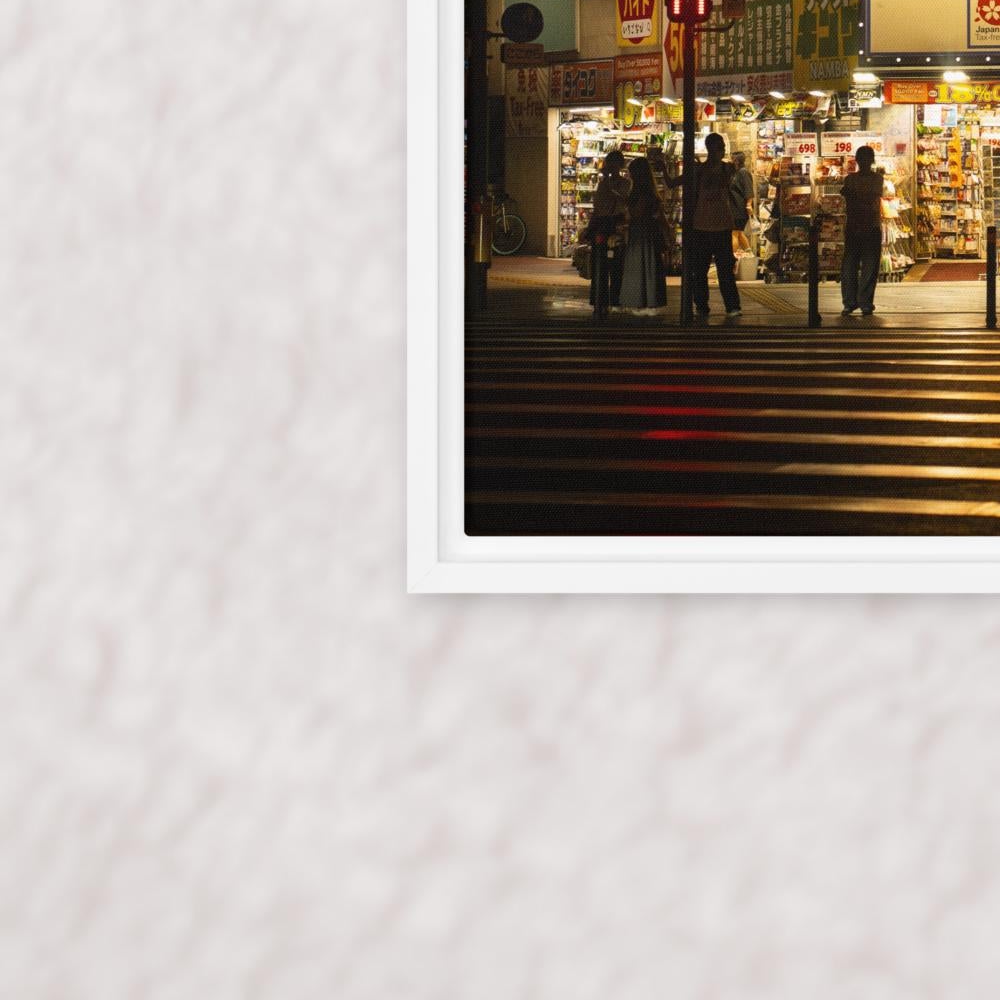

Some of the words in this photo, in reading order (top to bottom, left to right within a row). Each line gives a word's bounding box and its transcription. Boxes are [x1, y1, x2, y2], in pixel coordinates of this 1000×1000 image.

[565, 68, 597, 99] ダイコク
[798, 143, 816, 153] 698
[834, 142, 852, 152] 198
